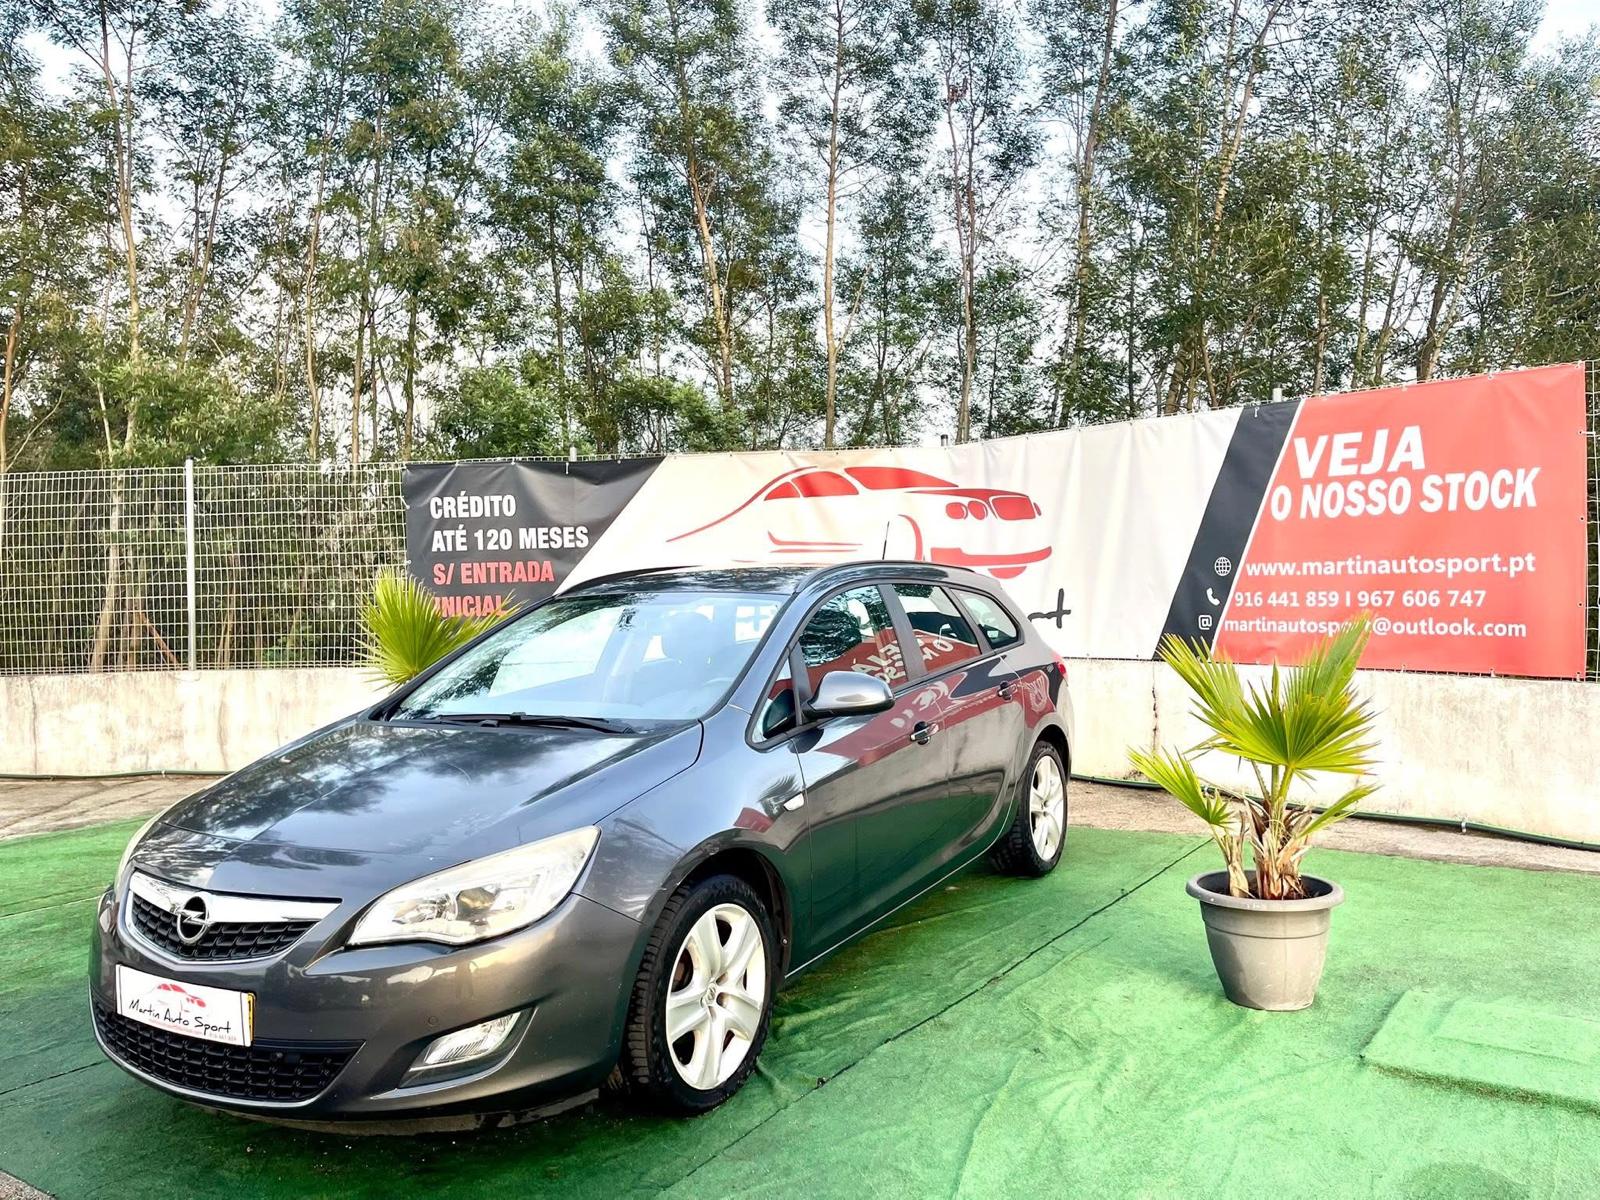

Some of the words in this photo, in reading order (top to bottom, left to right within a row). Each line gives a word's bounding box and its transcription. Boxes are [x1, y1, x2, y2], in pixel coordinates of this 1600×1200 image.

[1293, 425, 1426, 479] VEJA
[430, 491, 516, 520] CRÉDITO
[1270, 485, 1293, 522] O
[1300, 476, 1412, 519] NOSSO
[1420, 466, 1541, 513] STOCK
[431, 524, 468, 552] ATÉ
[474, 528, 512, 551] 120
[519, 526, 589, 550] MESES
[433, 562, 454, 585] S/
[460, 560, 555, 585] ENTRADA
[1245, 551, 1537, 579] www.martinautosport.pt
[1234, 591, 1262, 608] 916
[1267, 591, 1299, 608] 441
[1305, 590, 1340, 608] 859
[1357, 590, 1396, 607] 967
[1402, 589, 1439, 607] 606
[1447, 589, 1487, 607] 747
[129, 999, 160, 1019] Martin
[164, 1008, 190, 1027] Auto
[194, 1016, 232, 1036] Sport
